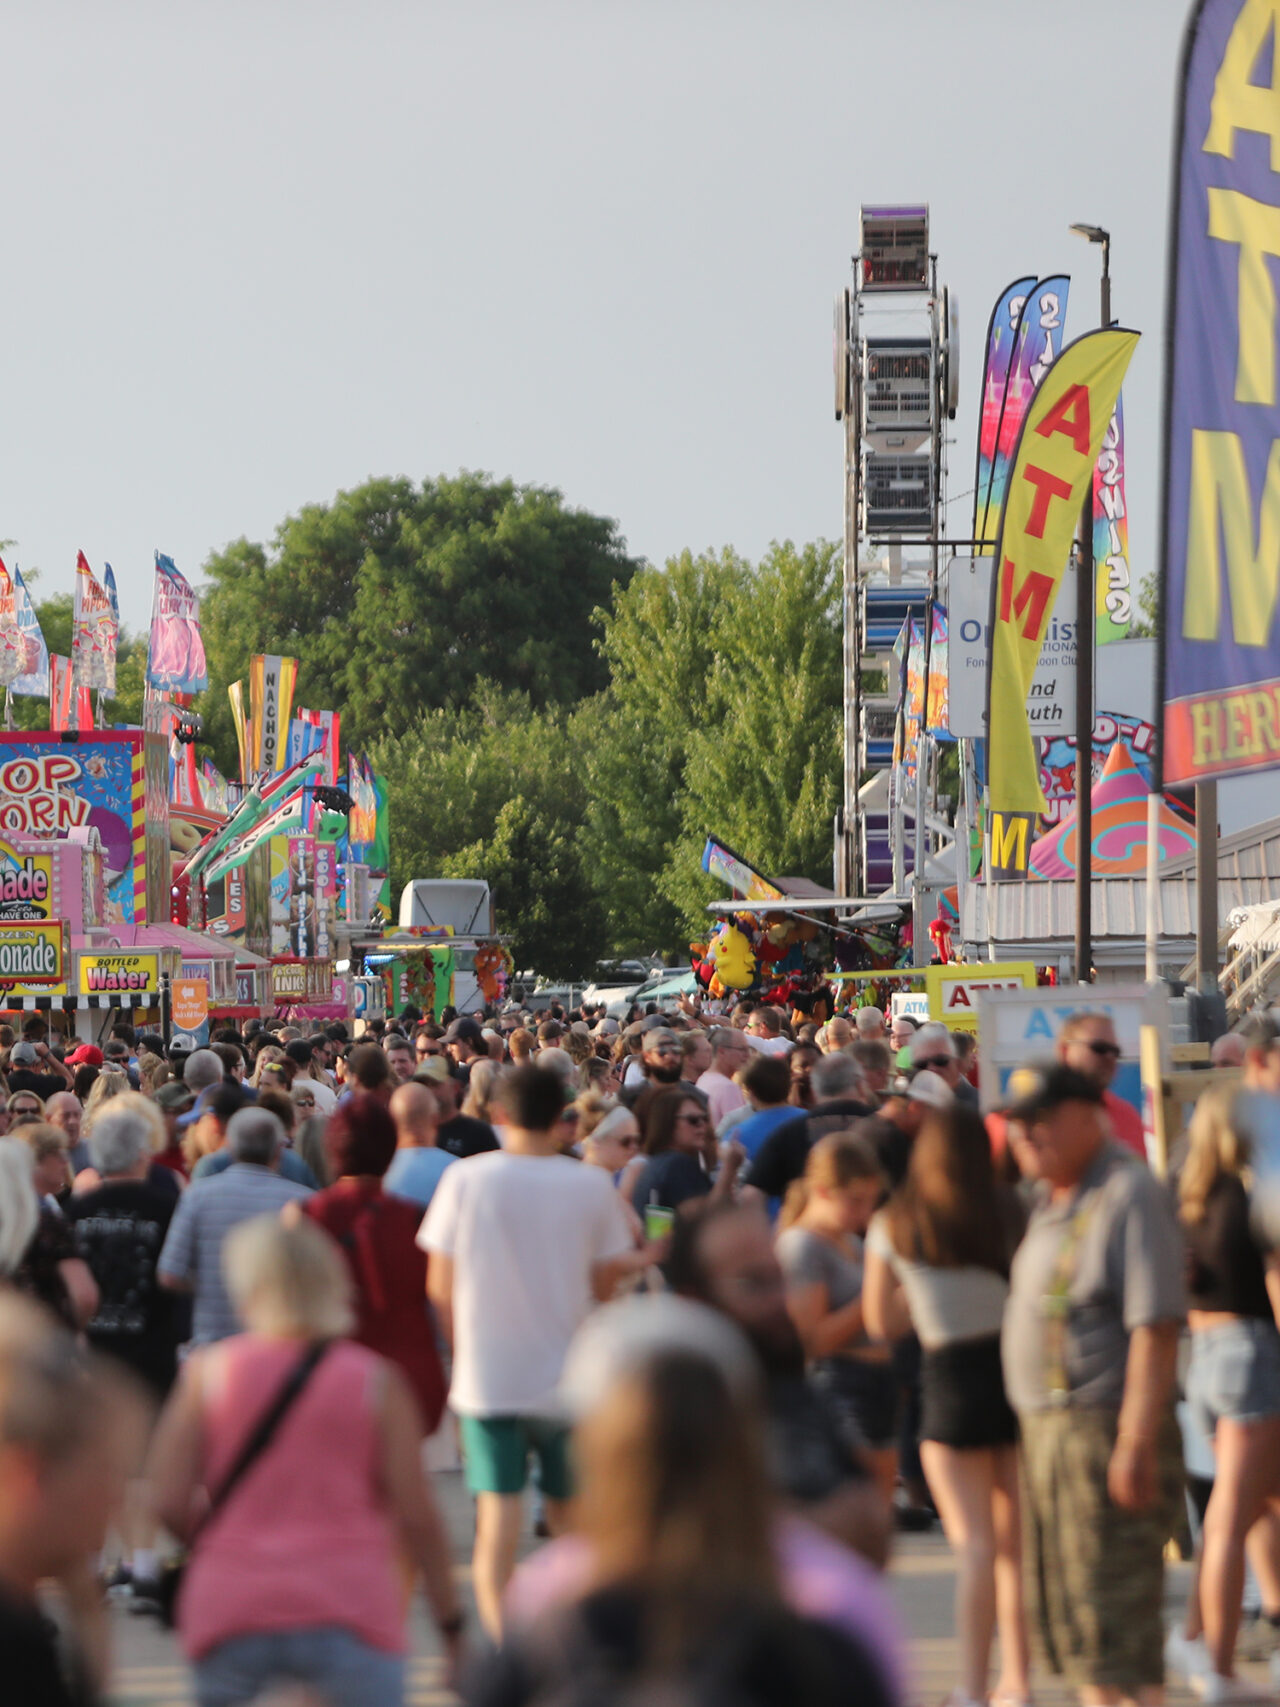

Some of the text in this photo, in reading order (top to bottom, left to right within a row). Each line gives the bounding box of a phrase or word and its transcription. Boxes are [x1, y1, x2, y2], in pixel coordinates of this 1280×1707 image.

[999, 383, 1091, 641] ATM
[264, 672, 277, 766] NACHOS
[1190, 686, 1280, 766] HER
[22, 911, 42, 920] ONE
[96, 958, 140, 967] BOTTLED
[87, 967, 150, 991] Water
[904, 1001, 928, 1013] ATM
